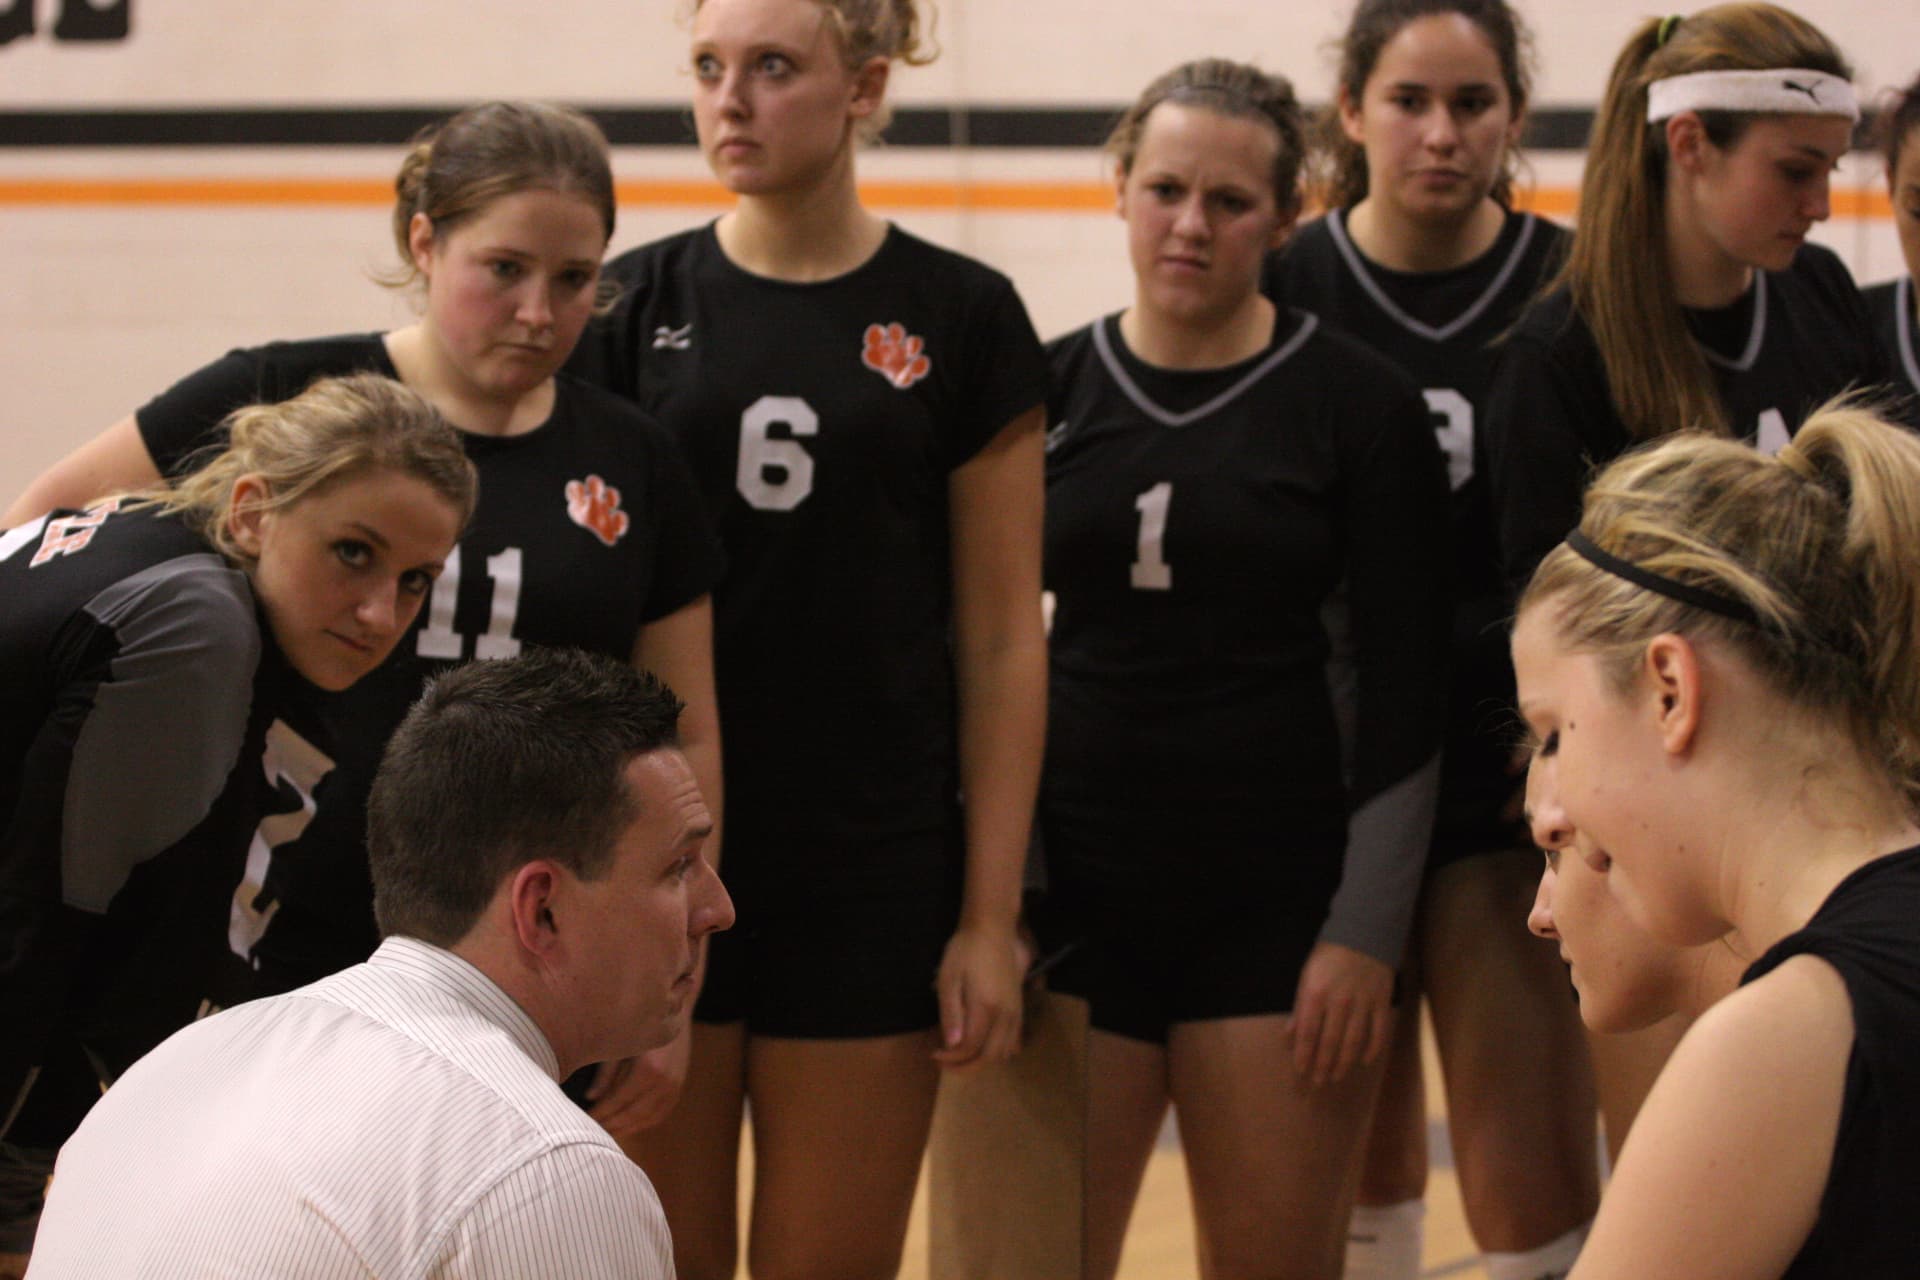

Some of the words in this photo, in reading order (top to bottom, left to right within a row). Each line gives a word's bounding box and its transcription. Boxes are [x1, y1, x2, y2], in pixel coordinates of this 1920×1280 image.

[736, 394, 820, 511] 6
[1129, 481, 1173, 590] 1
[416, 543, 523, 661] 11
